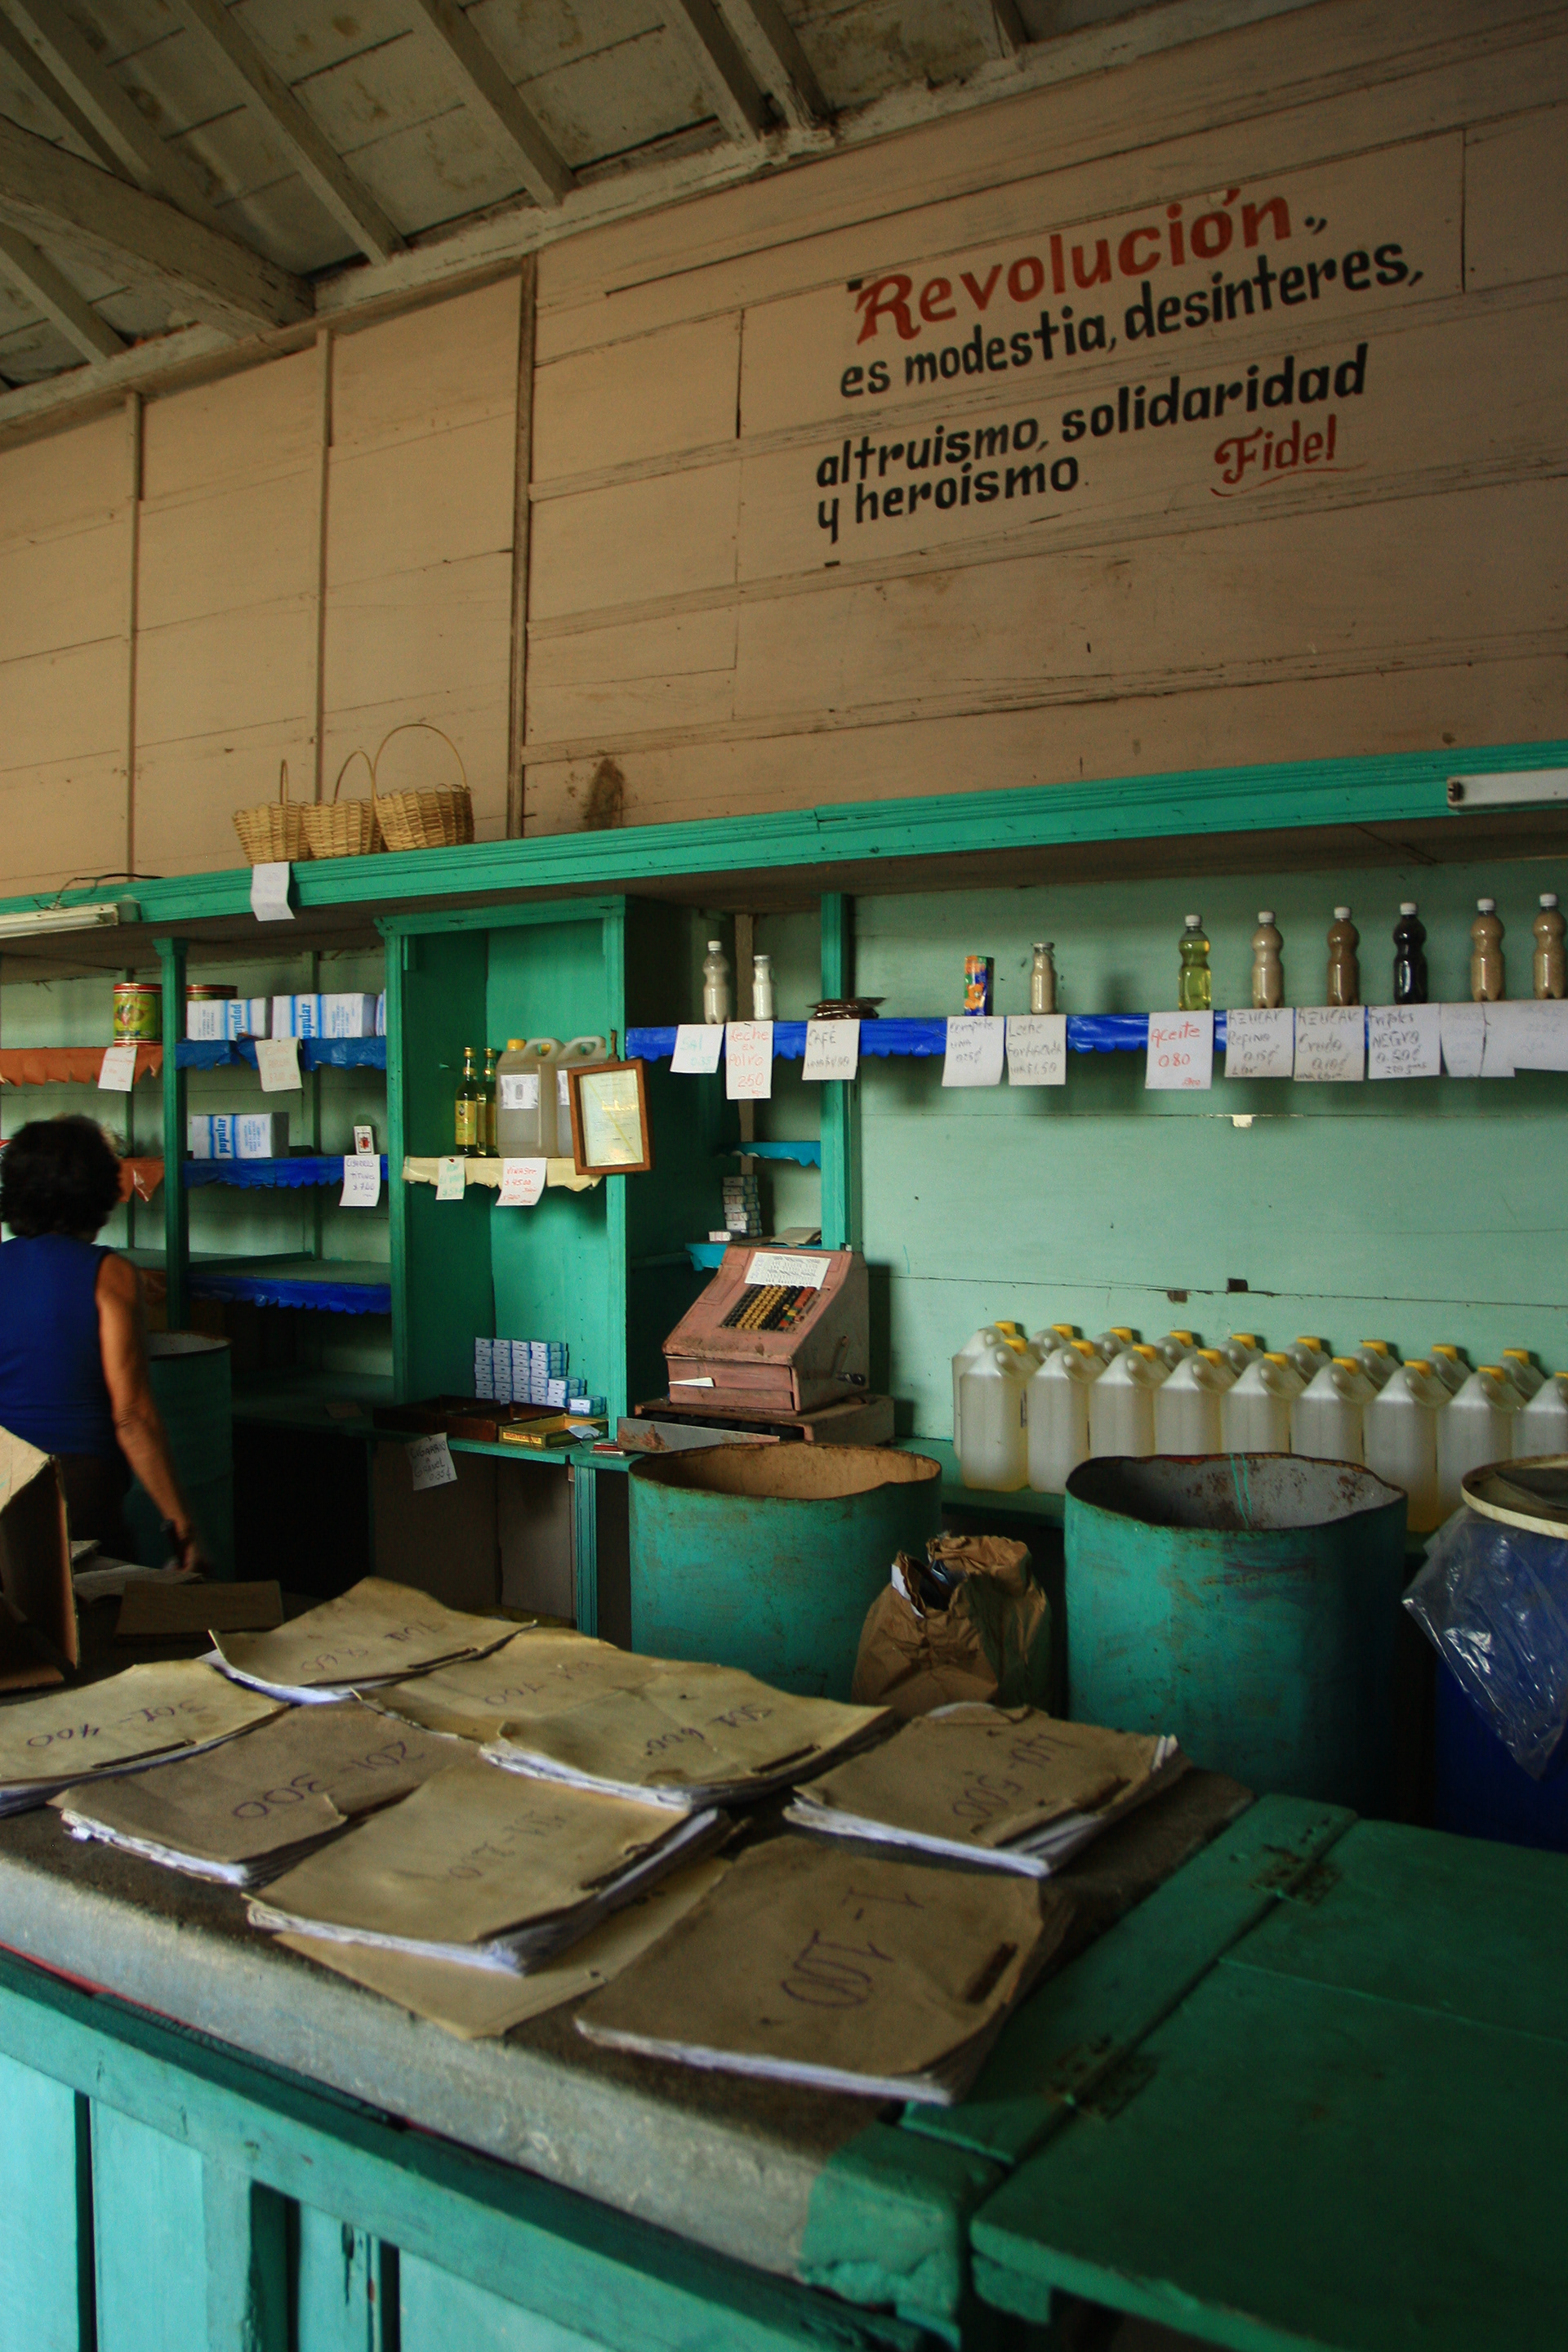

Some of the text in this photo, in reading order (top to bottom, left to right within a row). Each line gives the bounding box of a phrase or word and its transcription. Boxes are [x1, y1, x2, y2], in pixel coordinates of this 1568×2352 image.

[840, 243, 1424, 398] es modestia, desinteres,
[817, 342, 1369, 488] altruismo, solidaridad
[1214, 412, 1337, 484] Fidel
[817, 497, 840, 545] y
[216, 1118, 231, 1154] popular
